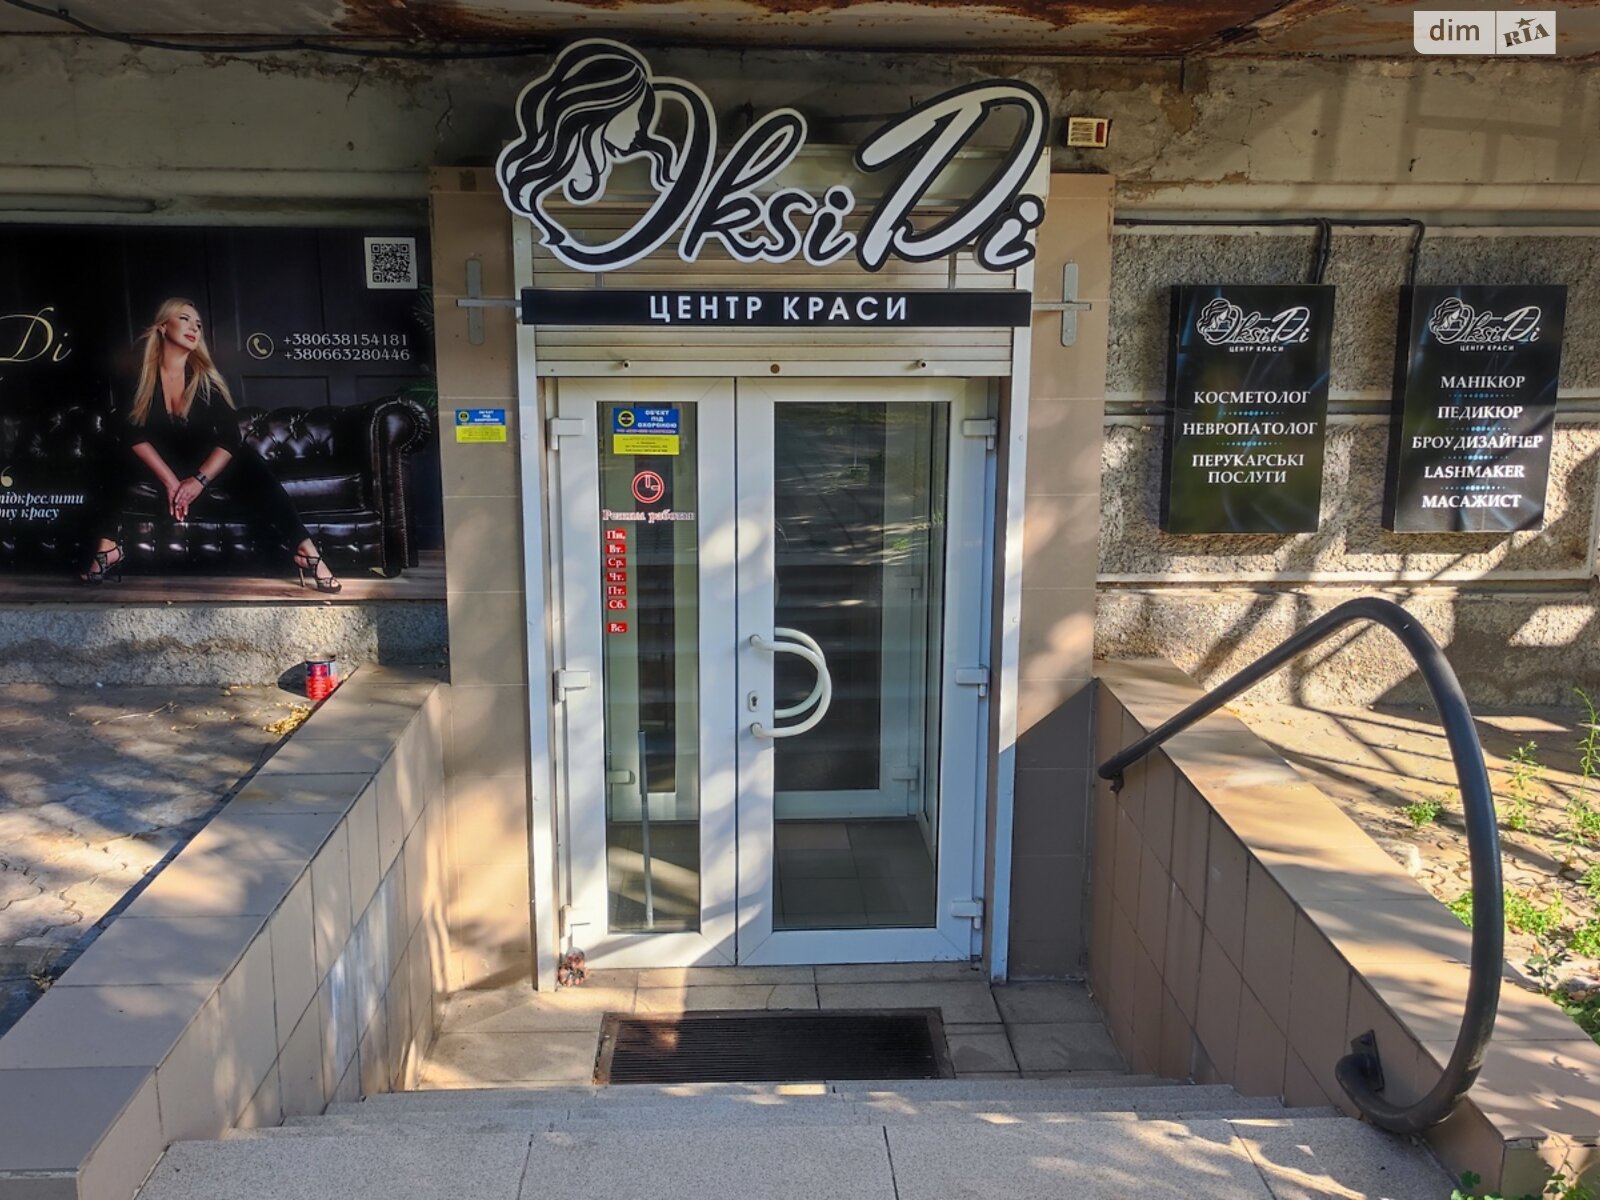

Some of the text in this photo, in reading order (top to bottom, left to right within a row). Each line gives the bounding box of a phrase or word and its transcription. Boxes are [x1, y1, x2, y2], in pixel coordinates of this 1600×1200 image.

[649, 295, 907, 323] ЦЕНТР КРАСИ
[283, 333, 408, 346] +380638154181
[284, 348, 411, 361] +380663280446
[1440, 375, 1526, 389] МАНІКЮР
[1194, 391, 1311, 404] КОСМЕТОЛОГ
[1437, 406, 1523, 420] ПЕДИКЮР
[1183, 422, 1318, 435] НЕВРОПАТОЛОГ
[1192, 454, 1304, 467] ПЕРУКАРСЬКІ
[1207, 471, 1286, 484] ПОСЛУГИ
[1424, 465, 1525, 478] LASHMAKER
[1421, 494, 1522, 508] МАСАЖИСТ
[21, 507, 60, 521] красу
[608, 558, 624, 568] Ср.
[609, 572, 624, 581] Чт.
[609, 600, 626, 609] Сб.
[610, 623, 625, 633] Вс.
